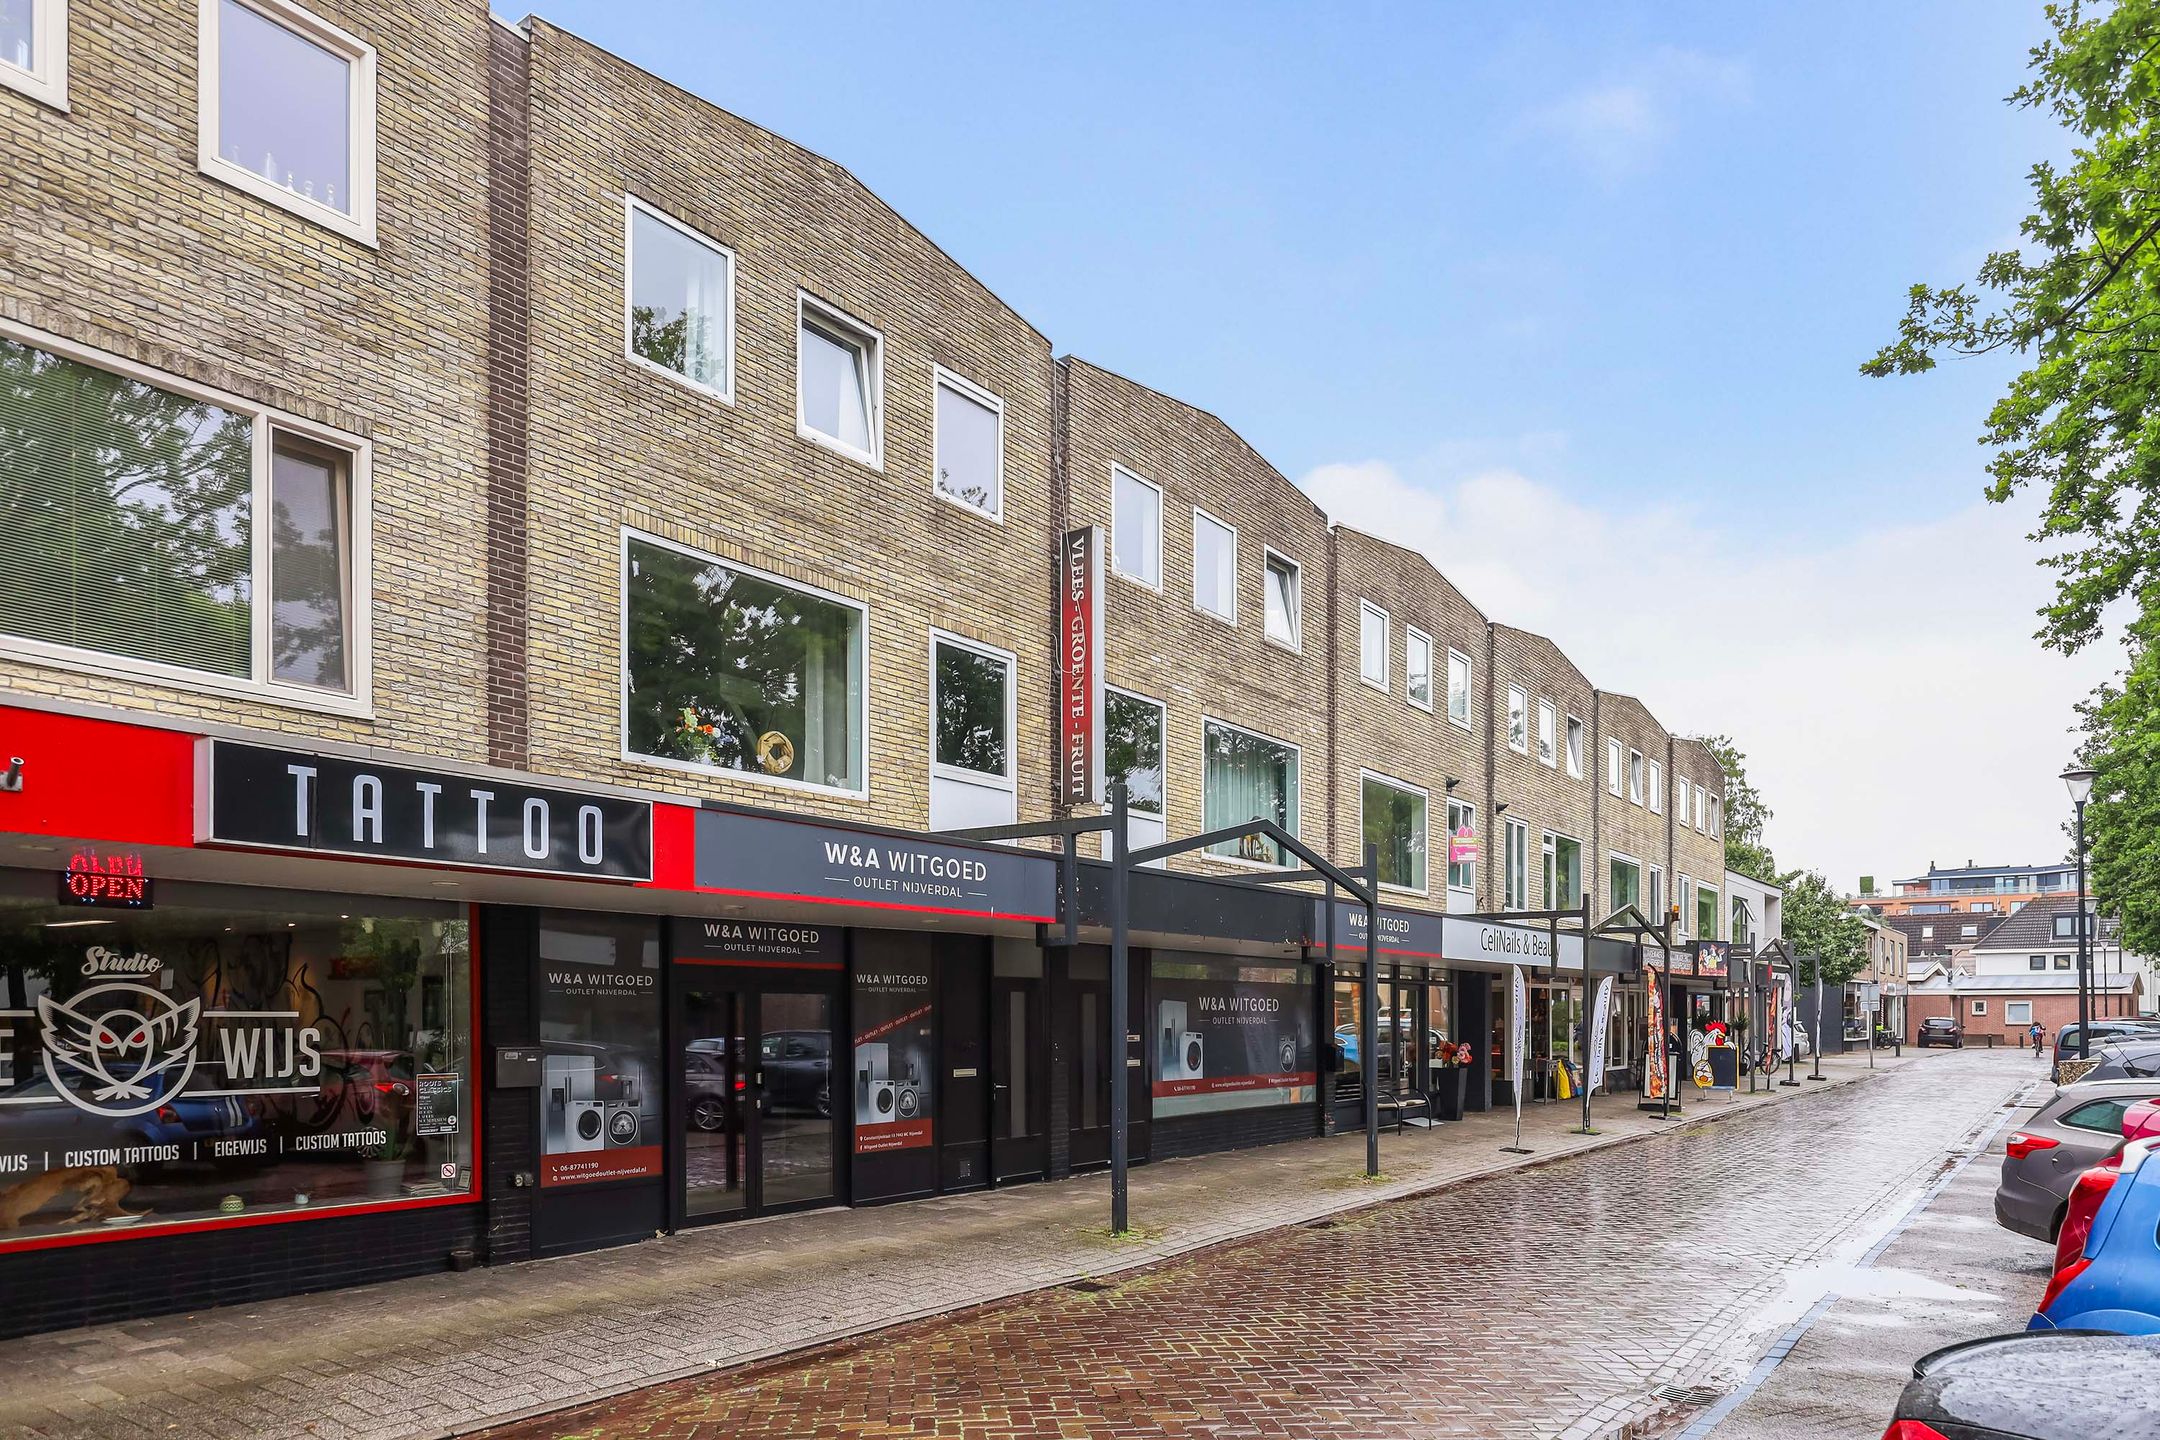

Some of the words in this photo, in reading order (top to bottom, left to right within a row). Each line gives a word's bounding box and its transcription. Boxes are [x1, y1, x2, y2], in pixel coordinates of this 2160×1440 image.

[1071, 535, 1085, 602] VLEES
[1071, 616, 1086, 719] GROENTE
[1071, 731, 1085, 797] FRUIT
[287, 764, 603, 865] TATTOO
[824, 841, 880, 869] W&A
[888, 850, 987, 882] WITGOED
[70, 874, 144, 899] OPEN
[853, 876, 898, 891] OUTLET
[902, 881, 963, 898] NIJVERDAL
[1348, 912, 1368, 927] W&A
[704, 923, 743, 939] W&A
[748, 926, 819, 943] WITGOED
[1480, 927, 1521, 954] CeliNails
[1523, 933, 1530, 955] &
[1532, 934, 1561, 960] Beauy
[81, 946, 164, 976] Studio
[723, 943, 756, 952] OUTLET
[758, 945, 802, 955] NIJVERDAL
[548, 972, 583, 984] W&A
[588, 973, 653, 986] WITGOED
[856, 974, 880, 984] W&A
[883, 974, 928, 985] WITGOED
[1199, 996, 1226, 1011] W&A
[1229, 997, 1279, 1012] WITGOED
[1212, 1016, 1235, 1024] OUTLET
[1236, 1017, 1267, 1025] NIJVERDAL
[220, 1027, 321, 1080] WIJS
[65, 1148, 121, 1169] CUSTOM
[124, 1144, 180, 1164] TATTOOS
[214, 1138, 267, 1157] EIGEWIJS
[295, 1134, 340, 1151] CUSTOM
[342, 1129, 387, 1147] TATTOOS
[559, 1162, 599, 1172] 06-87741190
